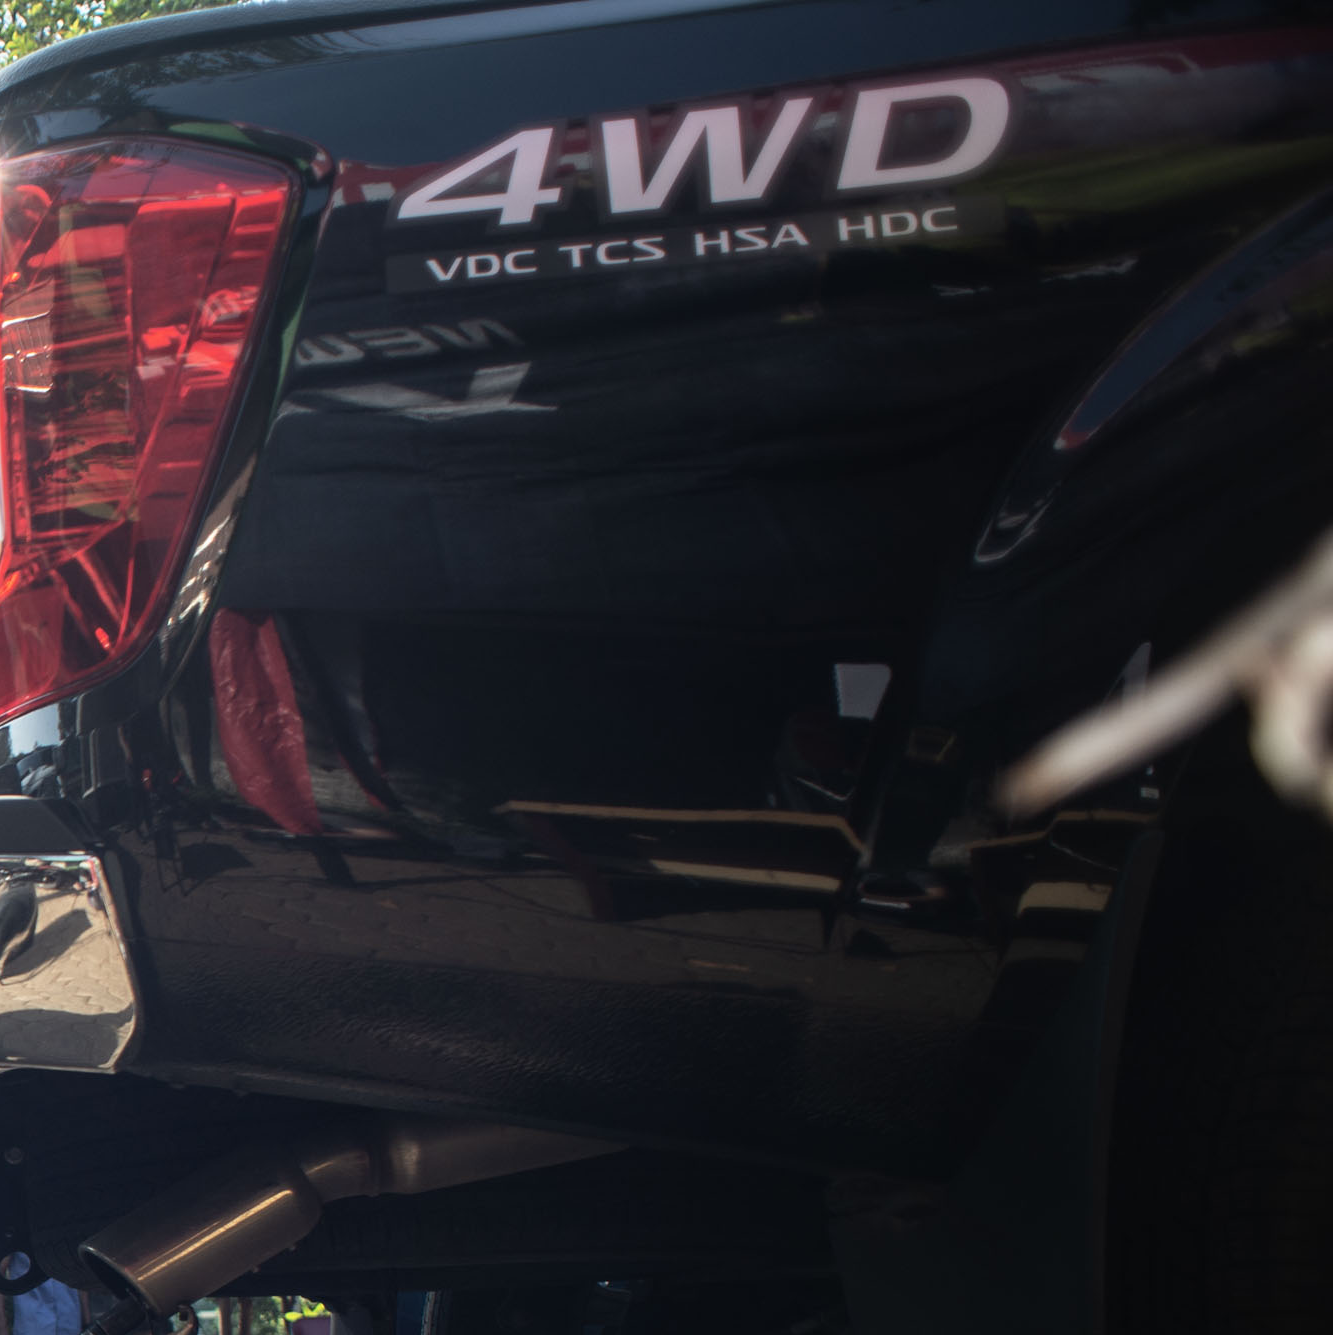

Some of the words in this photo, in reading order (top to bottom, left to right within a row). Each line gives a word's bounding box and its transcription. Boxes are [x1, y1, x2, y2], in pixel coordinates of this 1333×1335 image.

[397, 76, 1011, 226] 4WD
[426, 249, 538, 282] VDC
[558, 235, 667, 269] TCS
[693, 222, 810, 257] HSA
[837, 205, 959, 242] HDC
